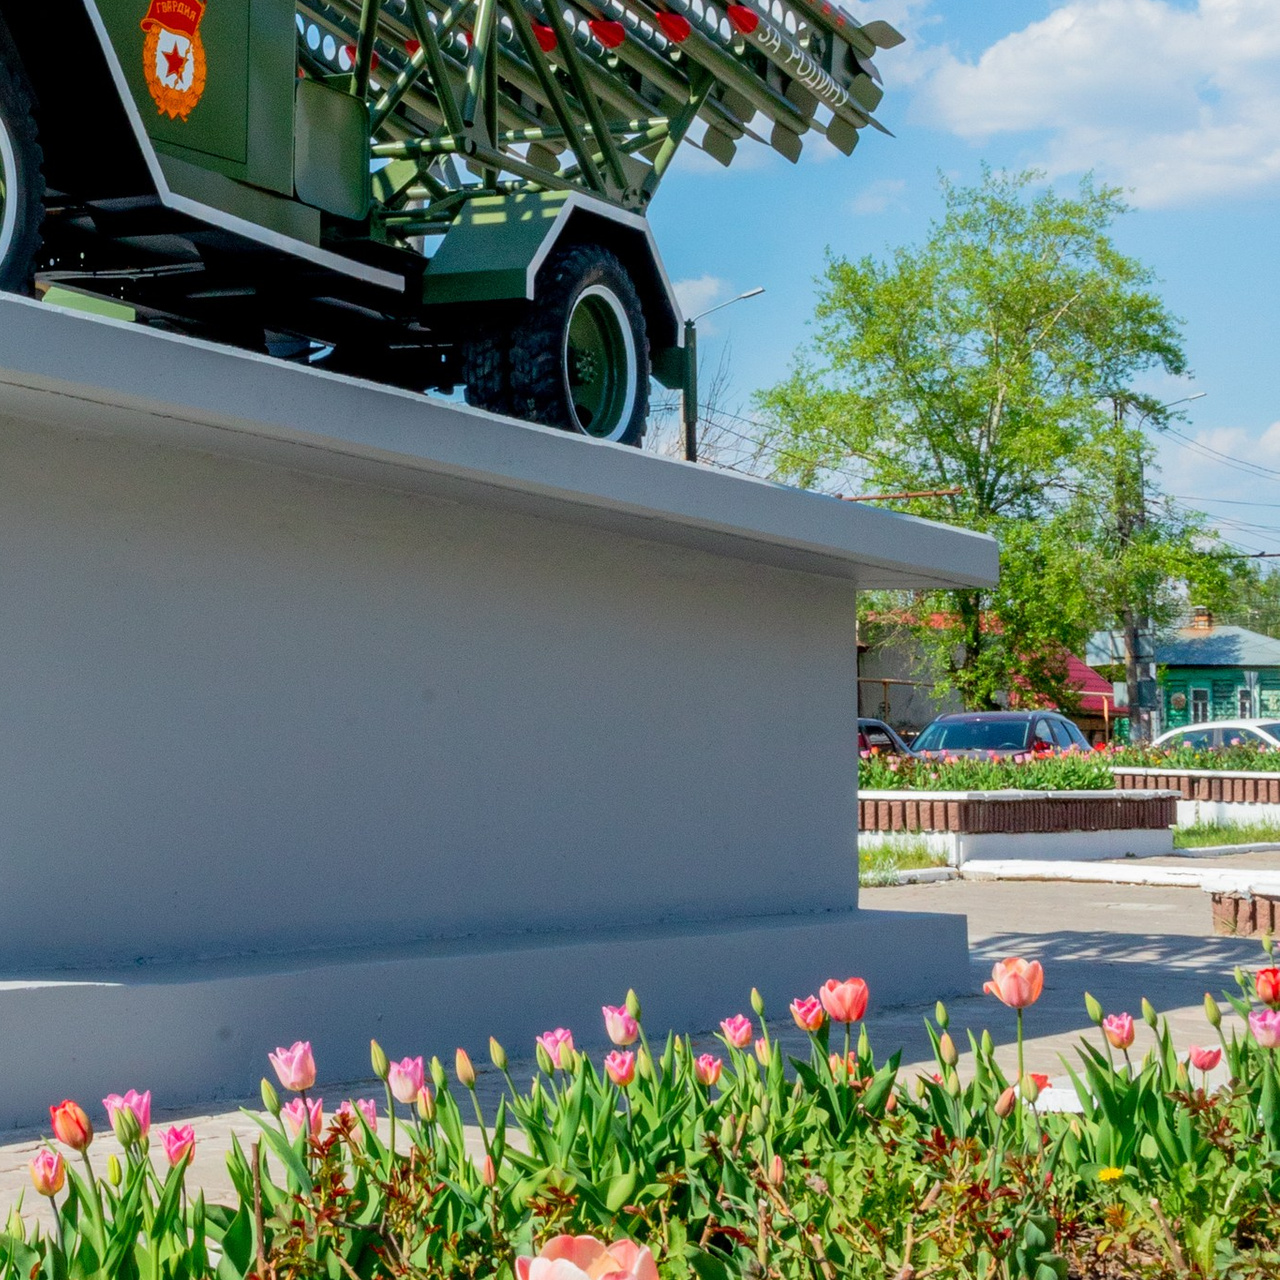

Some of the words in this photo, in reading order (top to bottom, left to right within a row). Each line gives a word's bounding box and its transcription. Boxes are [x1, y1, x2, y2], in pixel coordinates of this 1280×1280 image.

[156, 0, 197, 22] ГВАРДИЯ
[758, 24, 782, 53] ЗА
[784, 43, 850, 107] РОДИНУ
